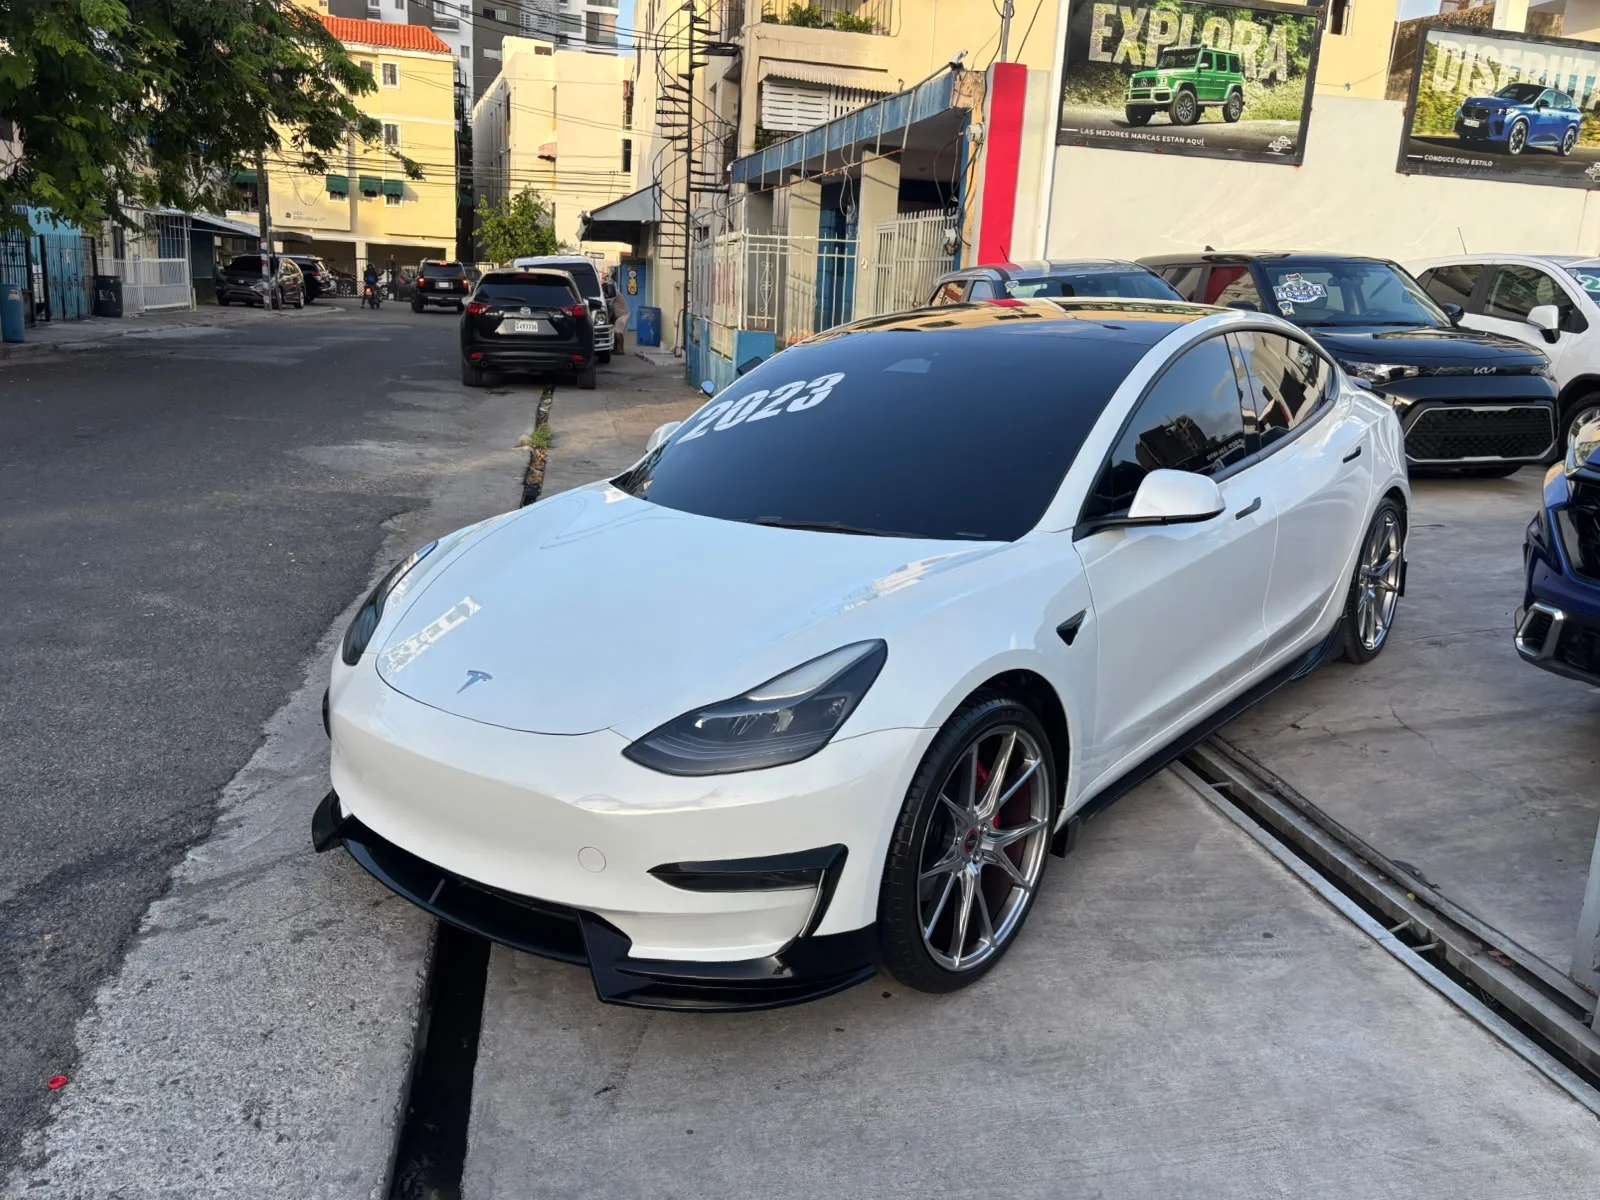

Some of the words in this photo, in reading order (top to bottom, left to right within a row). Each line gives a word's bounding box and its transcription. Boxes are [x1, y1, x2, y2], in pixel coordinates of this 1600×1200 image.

[1088, 3, 1289, 82] EXPLORA
[1080, 127, 1094, 135] LAS
[1096, 129, 1129, 138] MEJORES
[1131, 133, 1160, 142] MARCAS
[1162, 135, 1185, 143] ESTAN
[1424, 154, 1455, 163] CONDUCE
[676, 372, 846, 445] 2023
